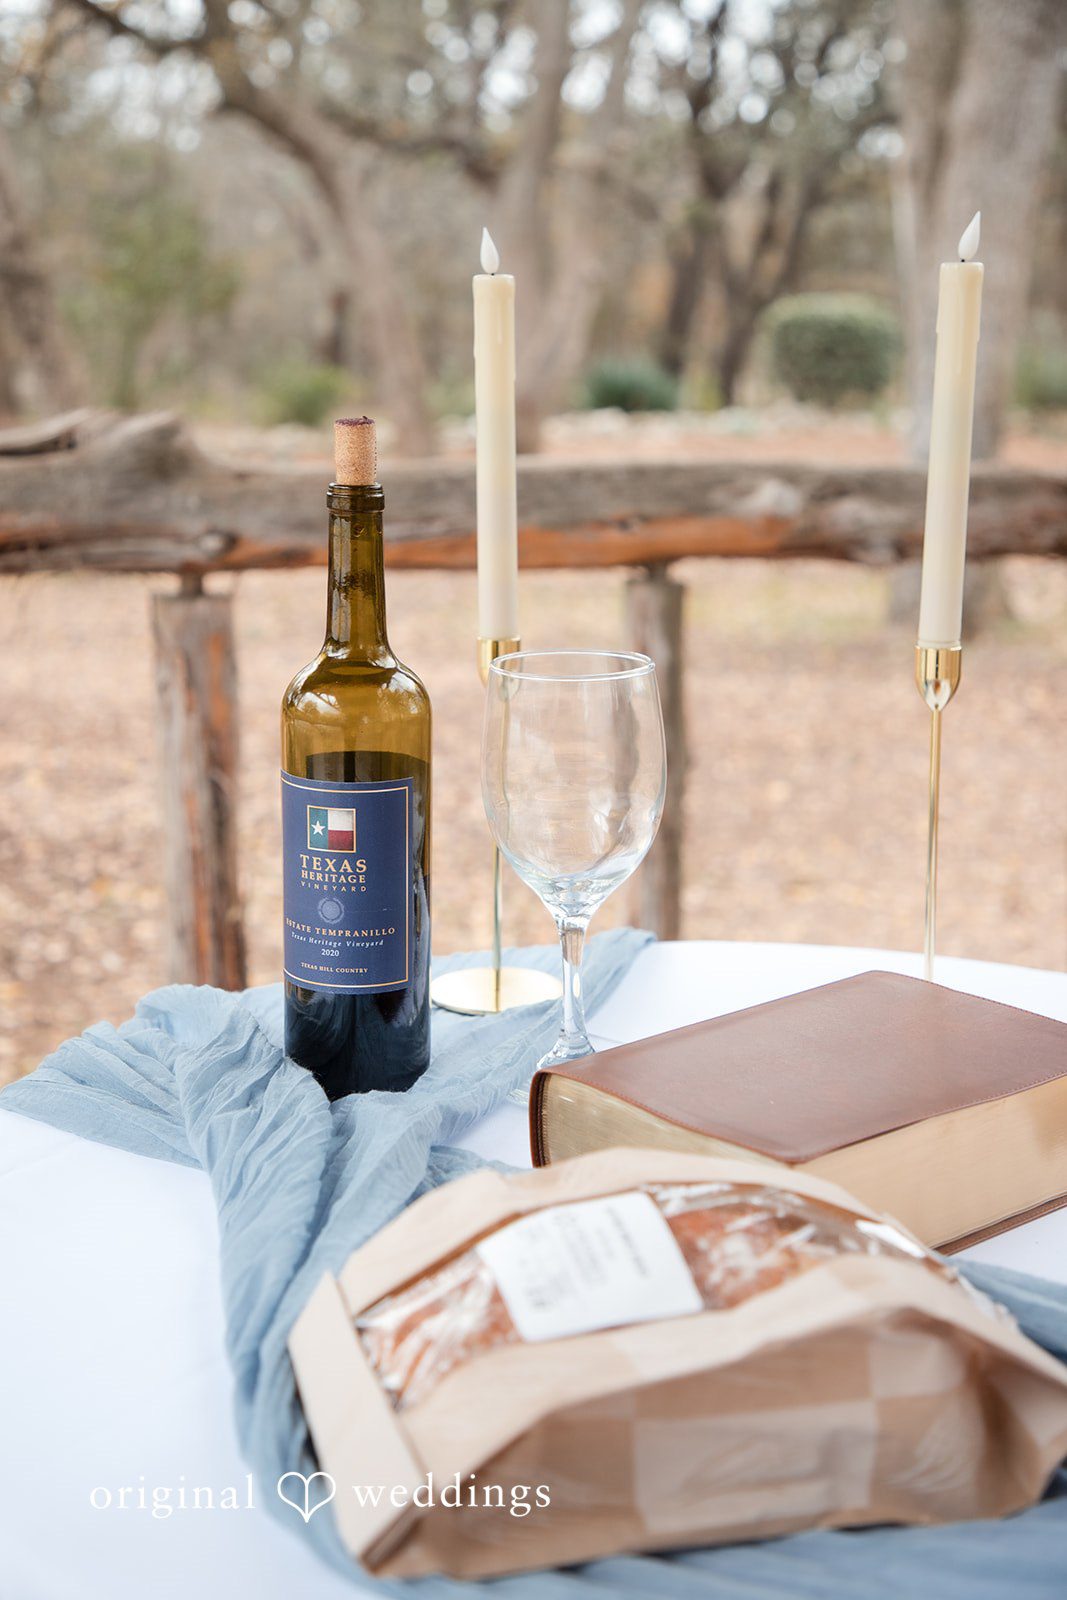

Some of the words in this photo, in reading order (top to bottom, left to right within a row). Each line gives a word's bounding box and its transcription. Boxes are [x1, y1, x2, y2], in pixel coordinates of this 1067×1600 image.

[299, 854, 367, 873] TEXAS
[301, 869, 366, 883] HERITAGE
[300, 880, 367, 892] VINEYARD
[315, 927, 395, 938] TEMPRANILLO
[291, 931, 307, 942] Texas
[308, 936, 342, 948] Heritage
[346, 939, 384, 949] Vineyard
[321, 948, 340, 957] 2020
[300, 961, 318, 970] TEXAS
[319, 965, 334, 973] HILL
[335, 966, 369, 974] COUNTRY
